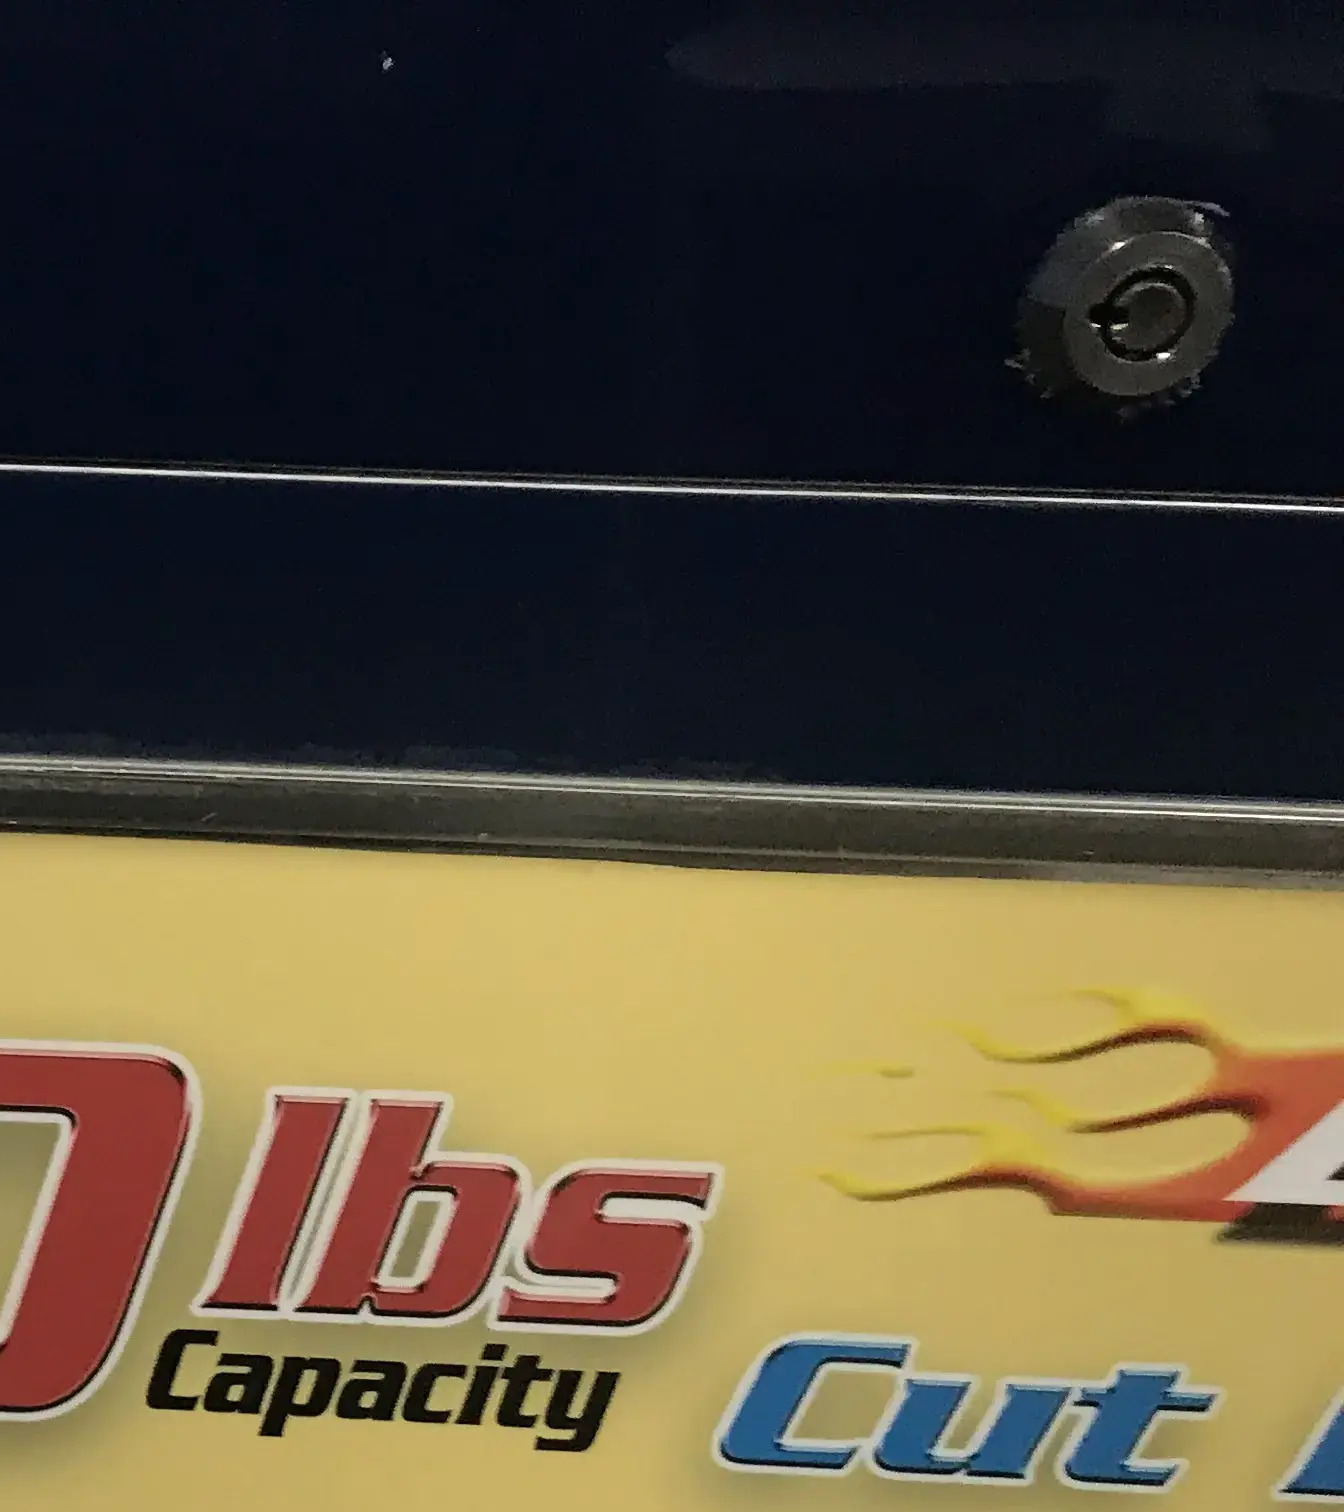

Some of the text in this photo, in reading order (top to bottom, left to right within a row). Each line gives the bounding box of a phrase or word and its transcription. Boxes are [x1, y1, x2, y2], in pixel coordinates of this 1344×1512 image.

[192, 1084, 723, 1335] lbs
[145, 1328, 621, 1453] Capacity
[713, 1330, 1227, 1494] Cut
